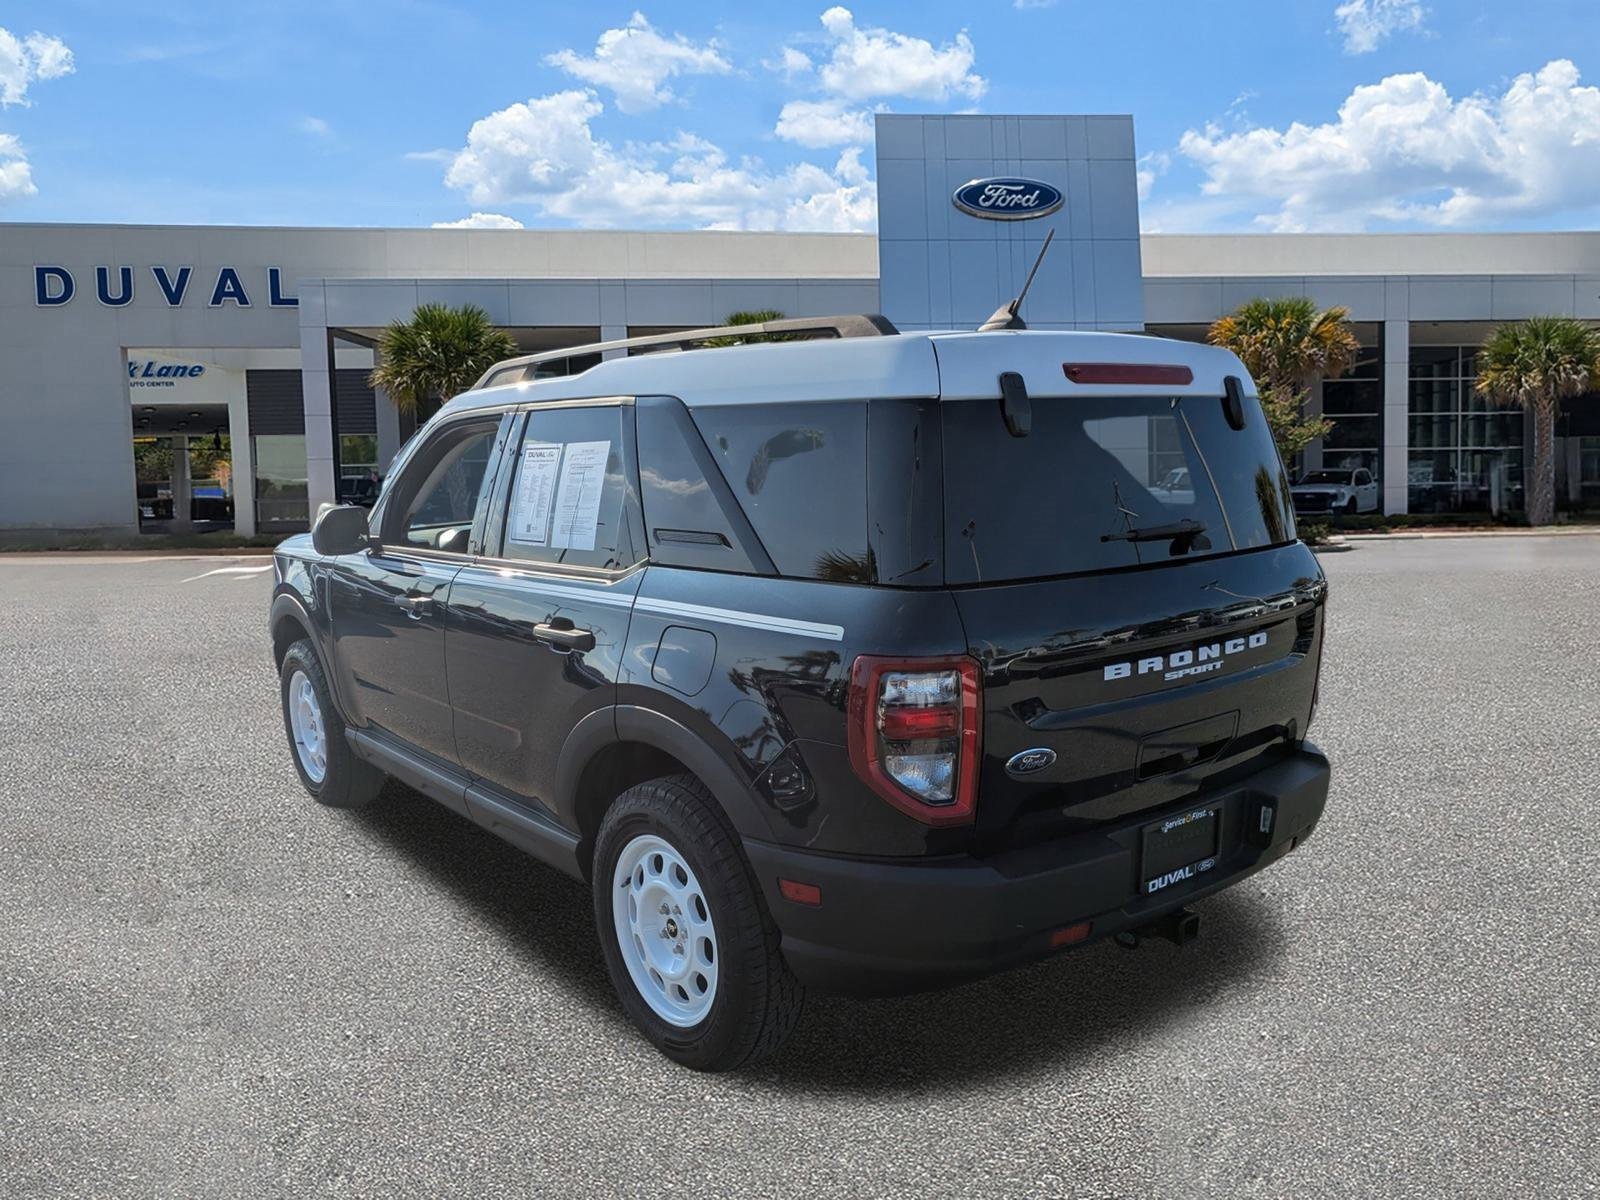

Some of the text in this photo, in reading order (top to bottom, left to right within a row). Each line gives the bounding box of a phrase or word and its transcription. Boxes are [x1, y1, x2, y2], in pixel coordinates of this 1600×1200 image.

[978, 184, 1040, 207] Ford
[34, 266, 299, 308] DUVAL
[141, 361, 205, 378] Lane
[1103, 632, 1267, 681] BRONCO
[1164, 660, 1224, 681] SPORT
[1020, 754, 1047, 770] Ford
[1148, 866, 1194, 893] DUVAL
